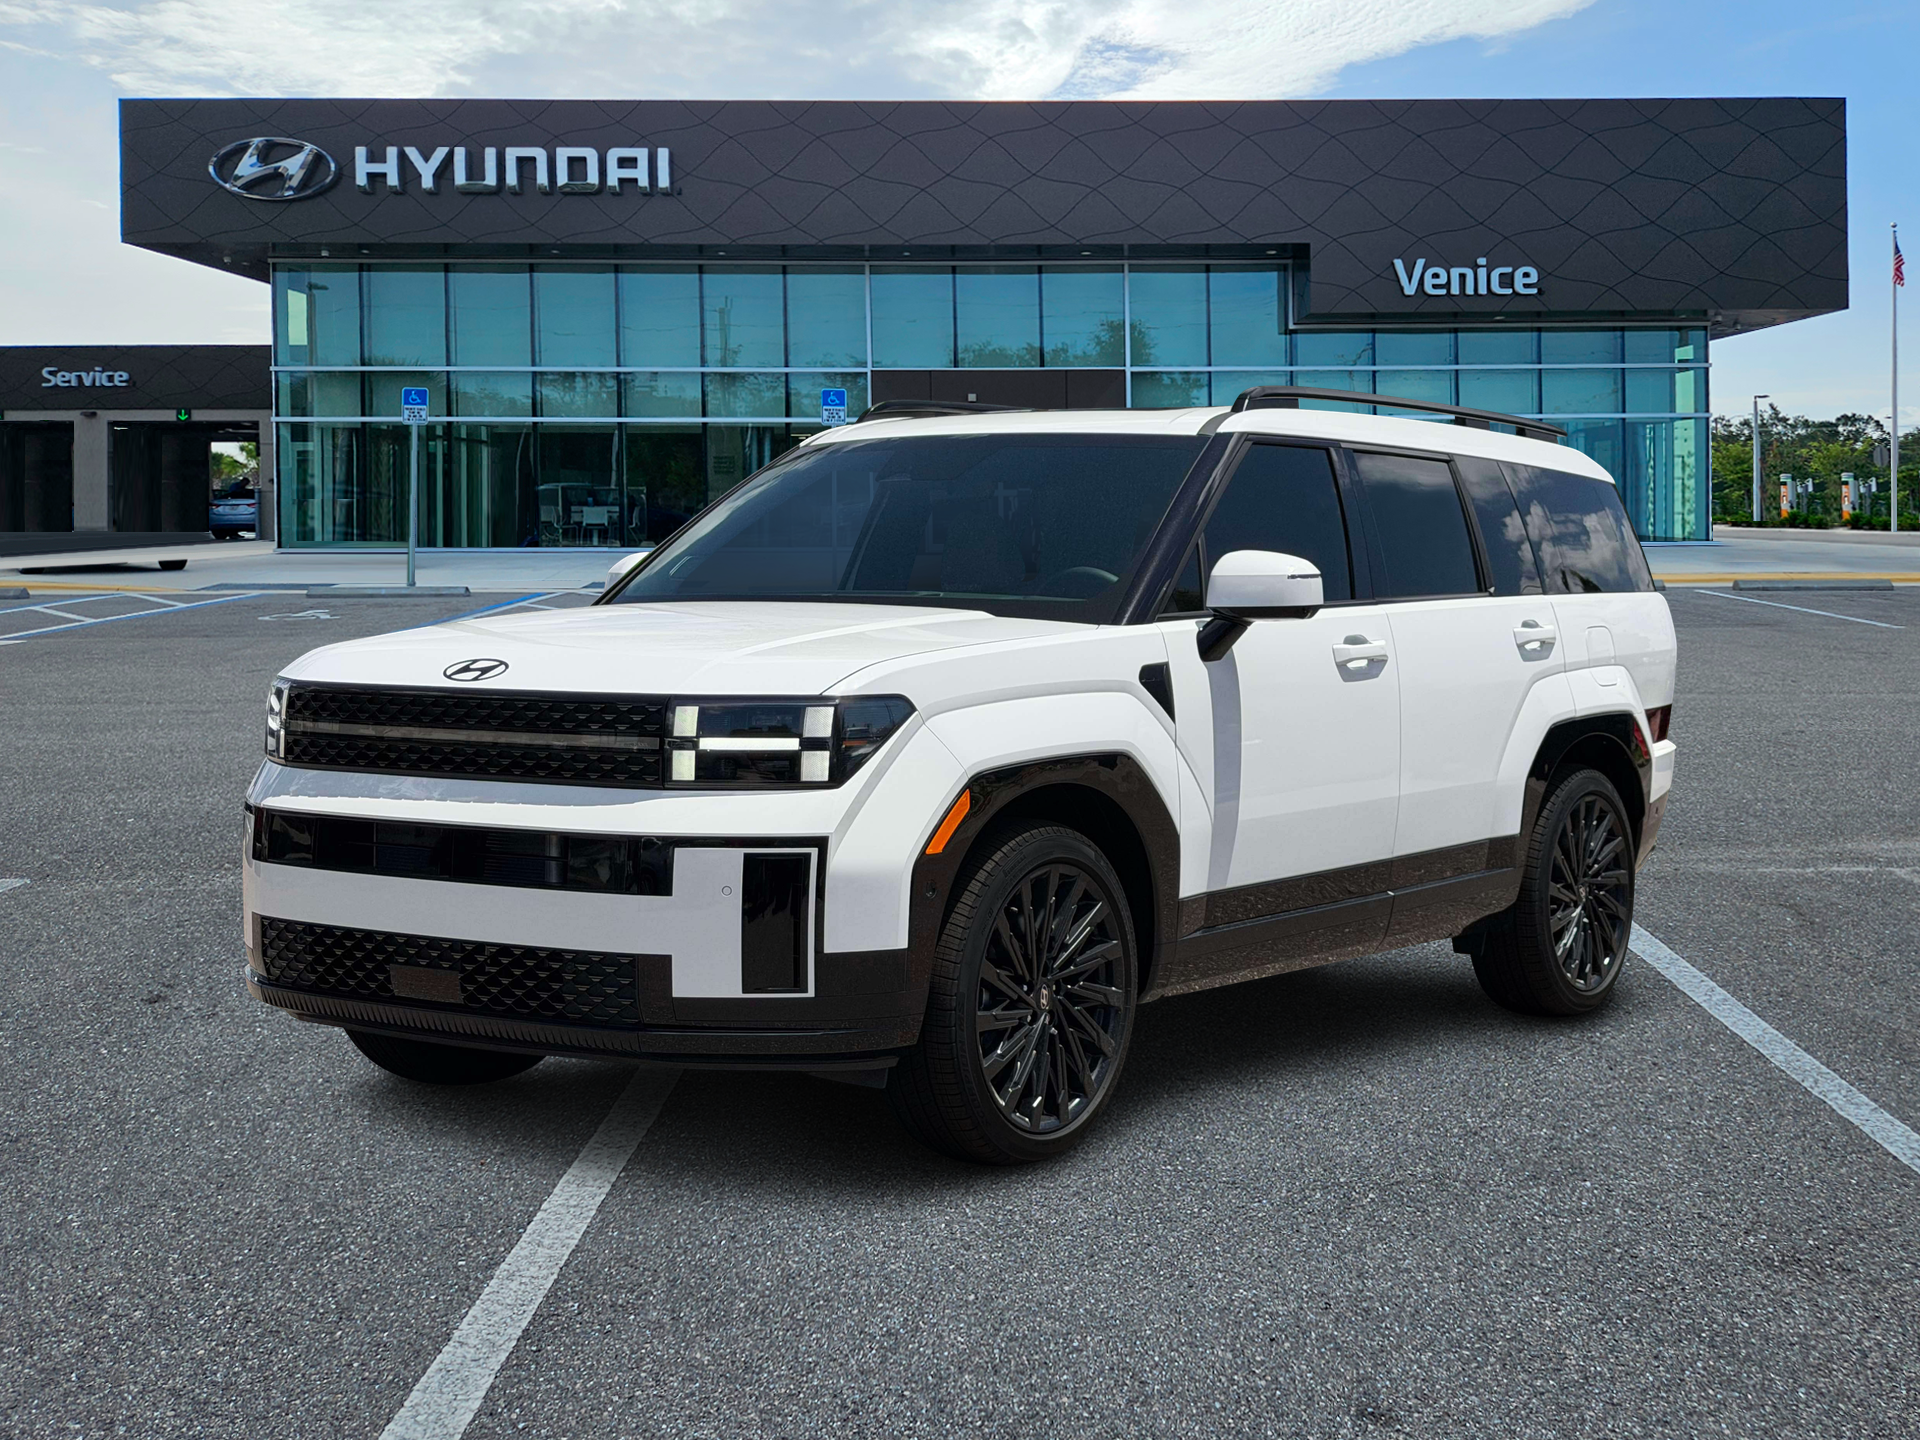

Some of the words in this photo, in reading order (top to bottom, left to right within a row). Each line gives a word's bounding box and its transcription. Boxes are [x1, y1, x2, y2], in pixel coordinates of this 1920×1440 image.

[354, 146, 670, 194] HYUNDAI
[1393, 257, 1538, 295] Venice
[41, 367, 129, 387] Service
